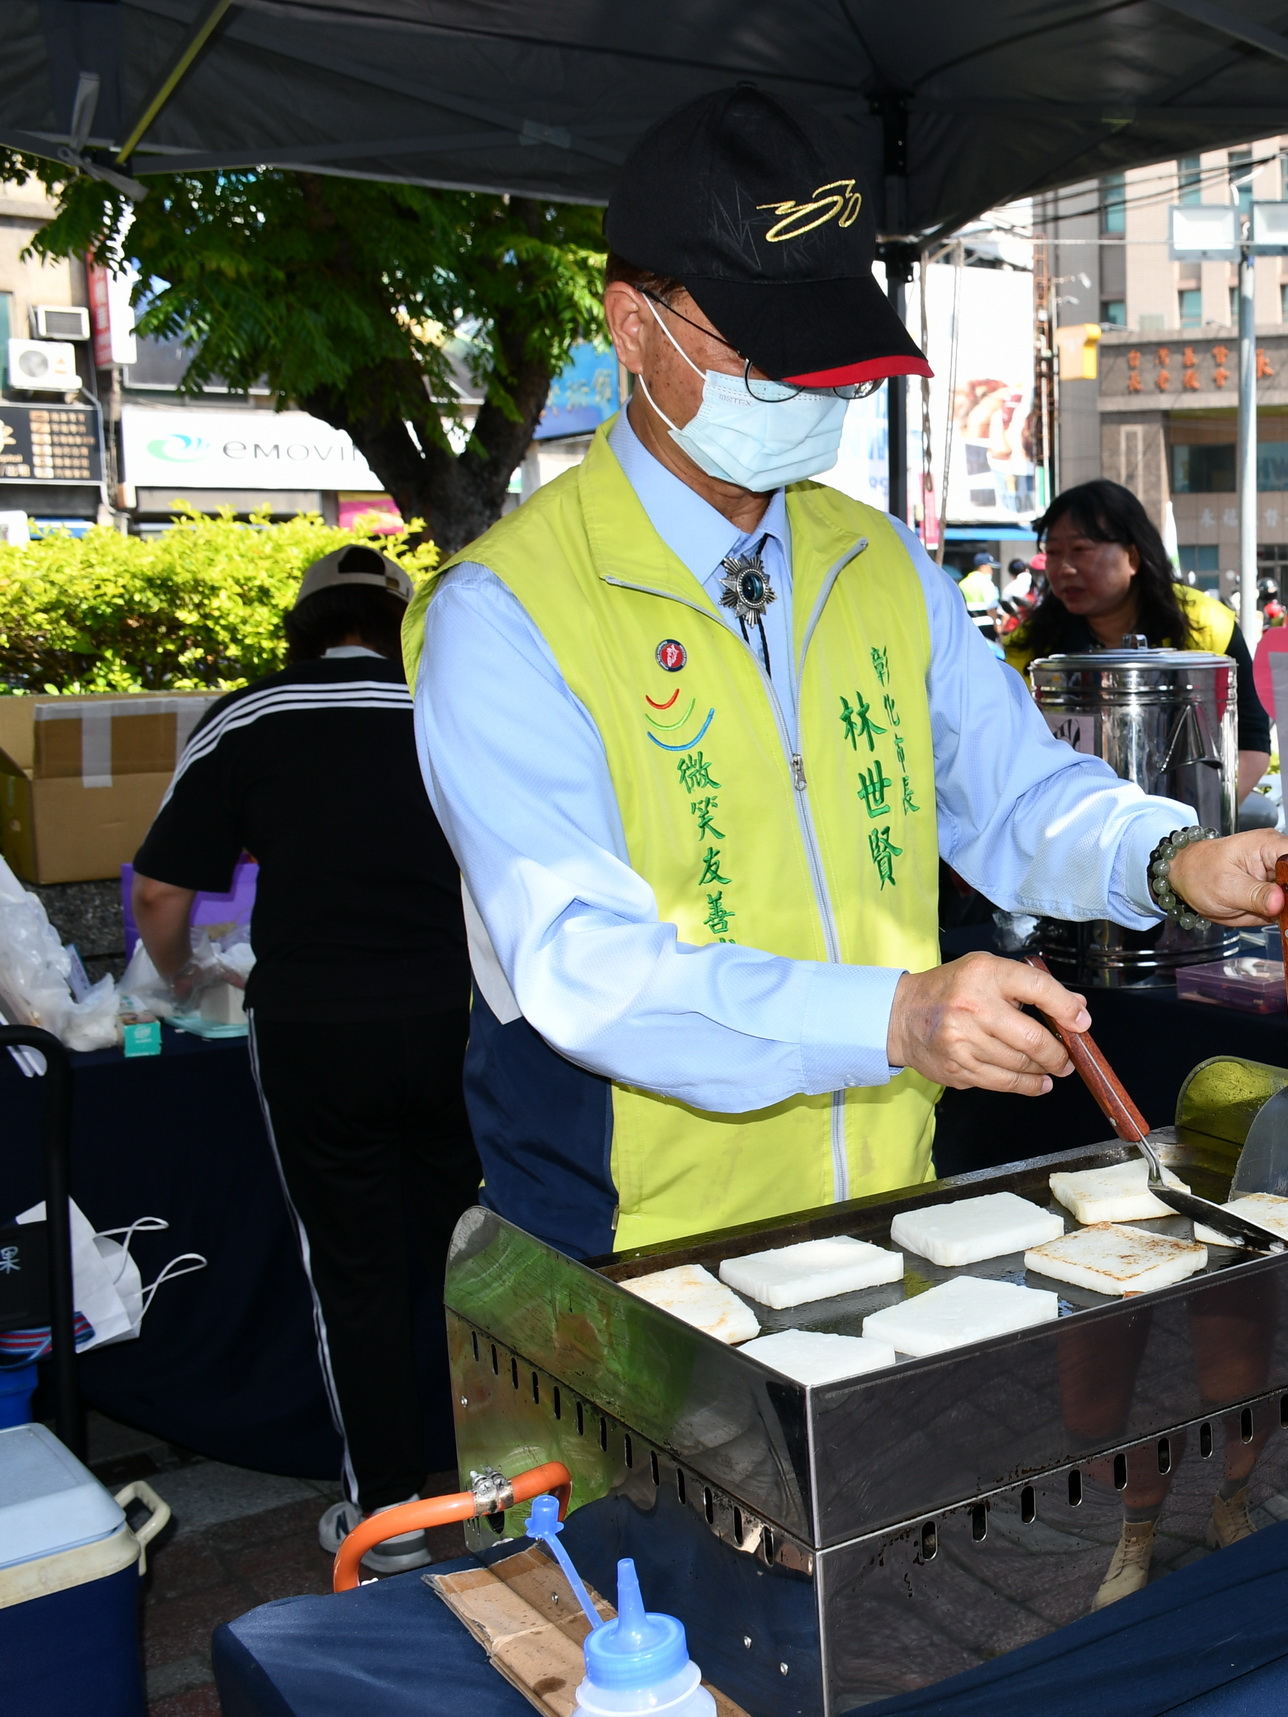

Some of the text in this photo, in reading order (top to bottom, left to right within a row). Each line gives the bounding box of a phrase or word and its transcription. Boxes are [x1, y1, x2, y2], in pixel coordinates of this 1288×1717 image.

[839, 690, 904, 891] 林世賢
[870, 646, 921, 816] 彰化市長
[676, 750, 737, 944] 微笑友善
